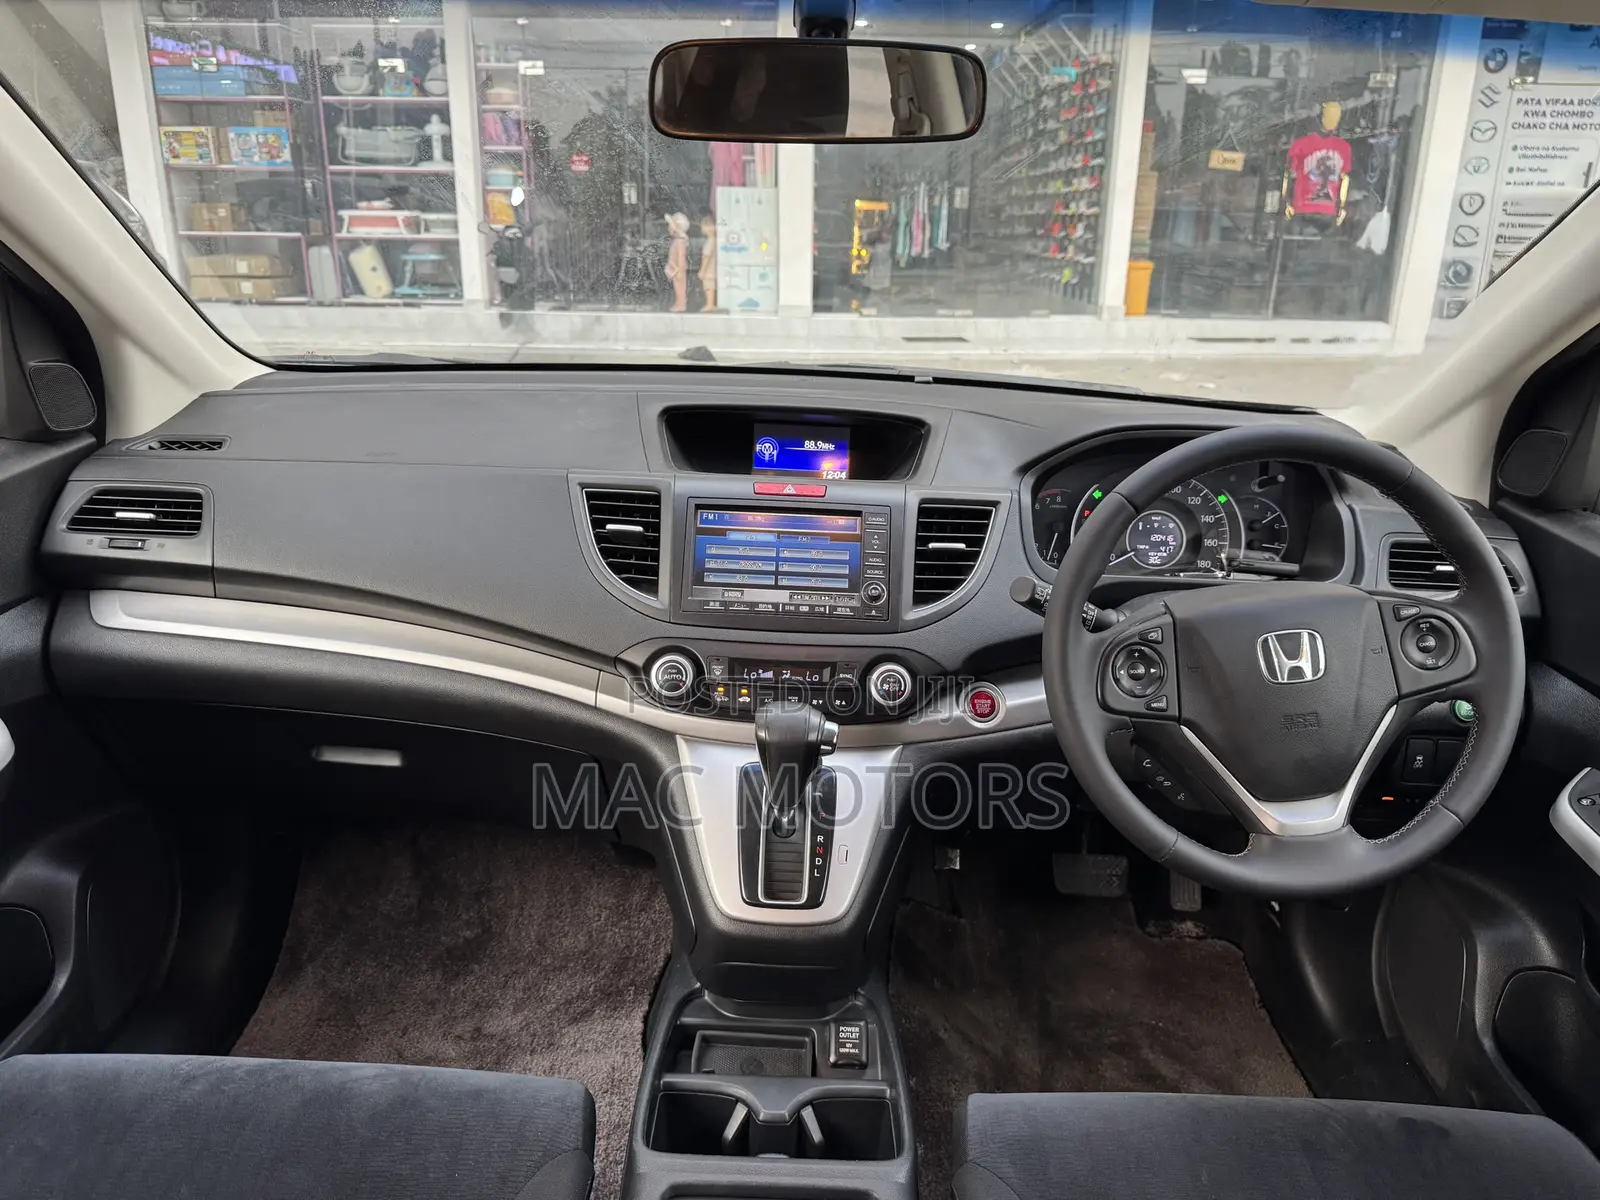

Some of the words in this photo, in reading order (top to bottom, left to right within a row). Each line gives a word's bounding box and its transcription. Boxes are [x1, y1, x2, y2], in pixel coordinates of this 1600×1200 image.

[1516, 97, 1542, 106] PATA
[1545, 98, 1574, 106] VIFAA
[1523, 110, 1547, 118] KWA
[1549, 110, 1594, 119] CHOMBO
[1511, 122, 1546, 130] CHAKO
[1548, 122, 1569, 130] CHA
[822, 471, 846, 479] 12:04
[1187, 497, 1202, 505] 120
[1201, 515, 1215, 523] 140
[1204, 539, 1218, 547] 160
[1197, 560, 1211, 568] 180
[817, 835, 824, 843] R
[816, 846, 824, 854] N
[814, 869, 820, 877] L
